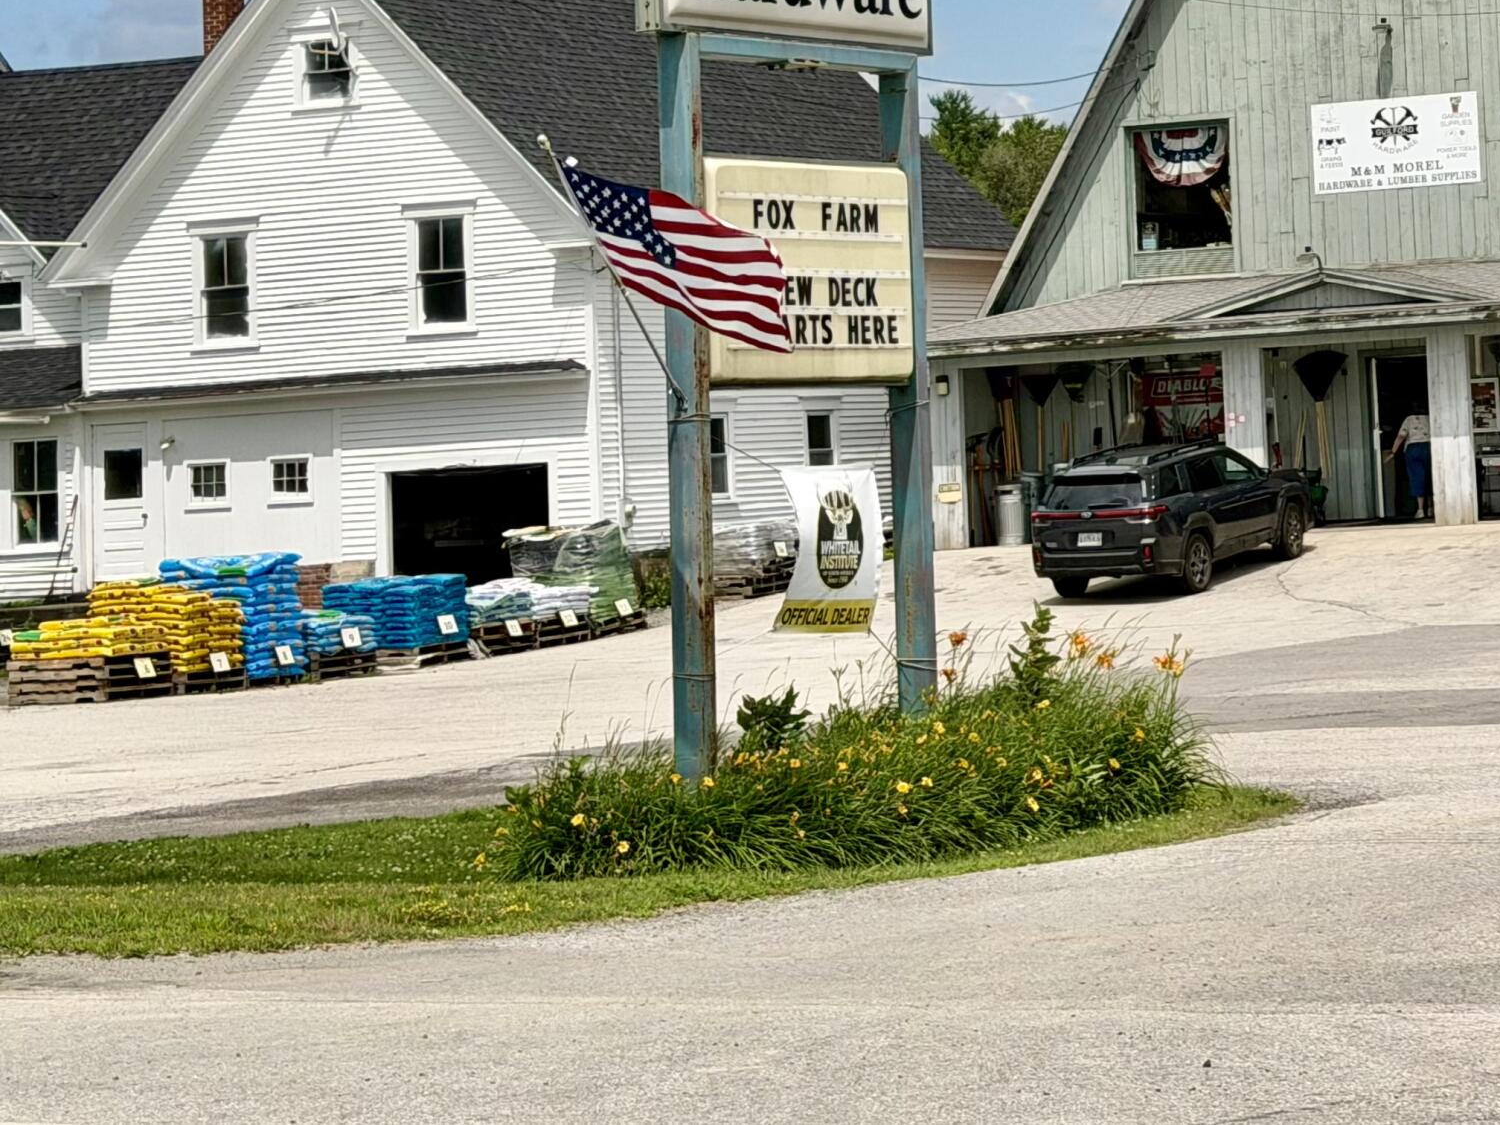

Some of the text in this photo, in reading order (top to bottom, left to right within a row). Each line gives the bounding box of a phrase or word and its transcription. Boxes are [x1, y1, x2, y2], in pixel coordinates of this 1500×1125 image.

[1375, 125, 1414, 136] GUILFORD
[1351, 160, 1444, 176] M&M MOREL
[1318, 178, 1373, 191] HARDWARE
[1388, 174, 1428, 186] LUMBER
[1431, 170, 1477, 182] SUPPLIES
[753, 199, 879, 233] FOX FARM
[781, 275, 879, 307] EW DECK
[848, 315, 899, 345] HERE
[821, 540, 861, 554] WHITETAIL
[820, 554, 858, 569] INSTITUTE
[781, 607, 870, 625] OFFICIAL DEALER
[348, 633, 355, 643] 9
[216, 658, 222, 668] 7
